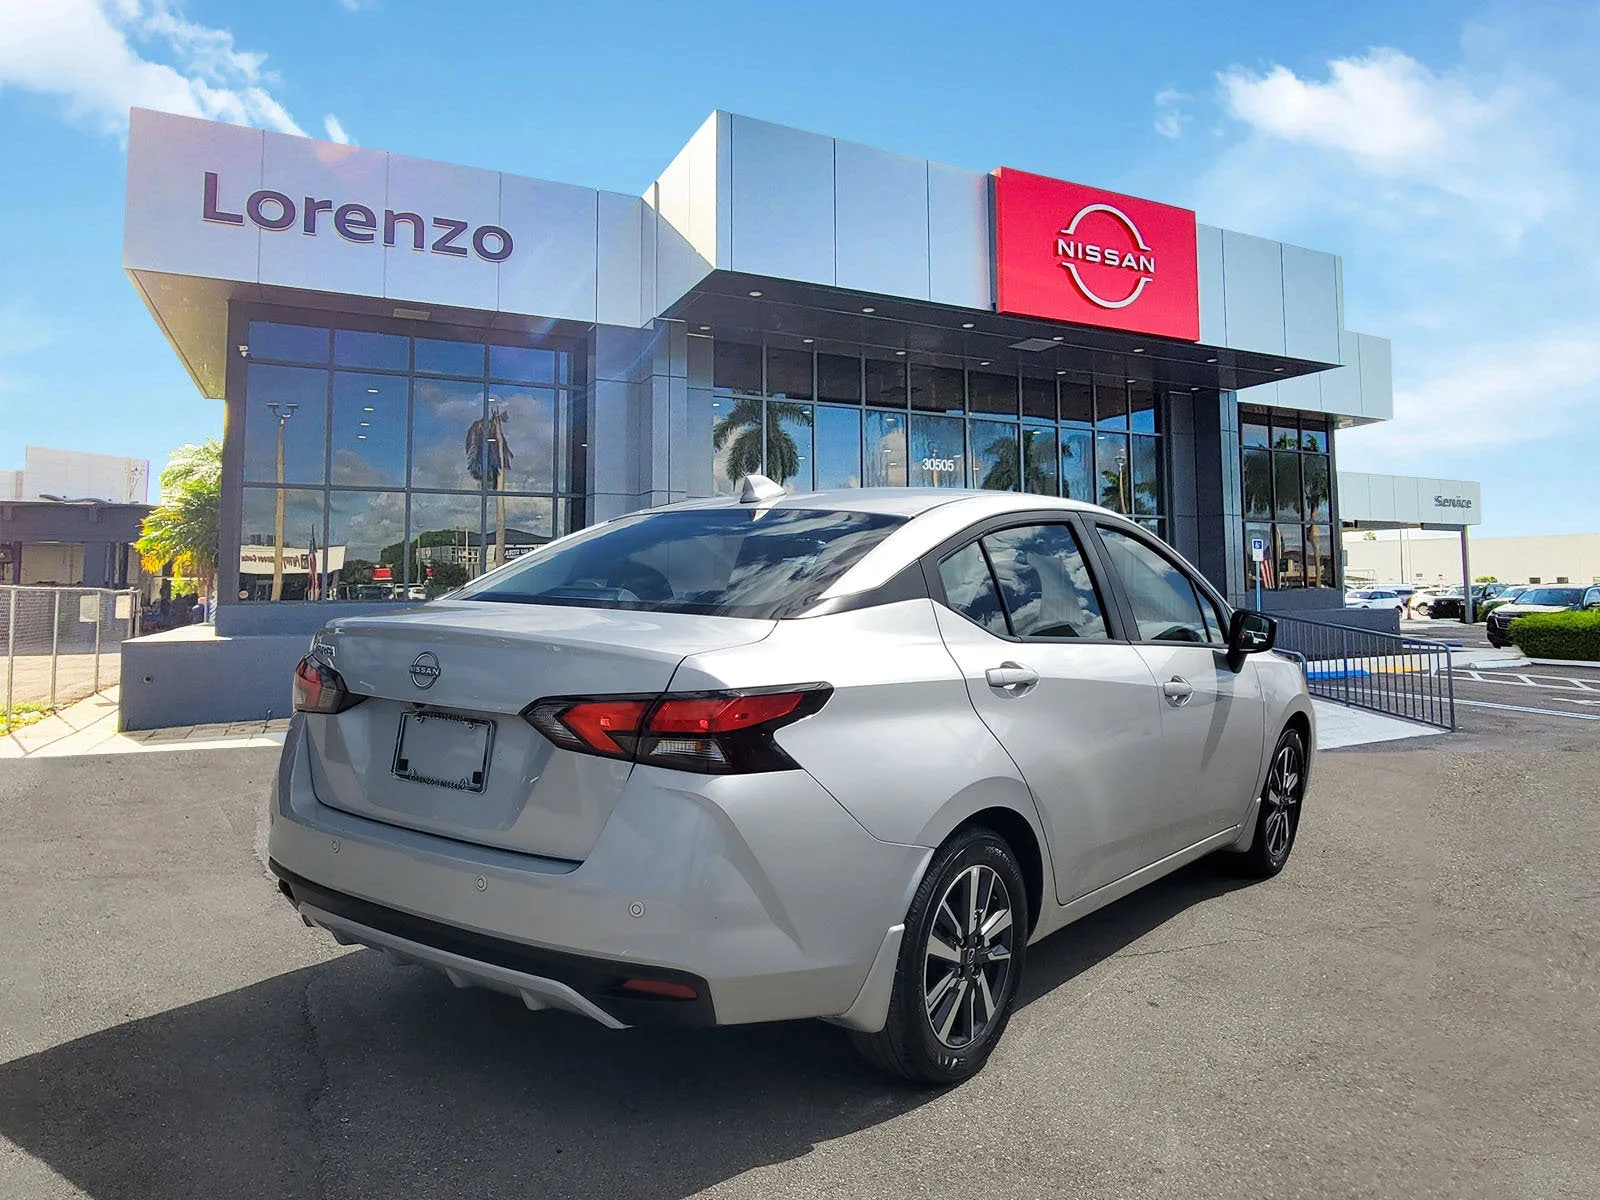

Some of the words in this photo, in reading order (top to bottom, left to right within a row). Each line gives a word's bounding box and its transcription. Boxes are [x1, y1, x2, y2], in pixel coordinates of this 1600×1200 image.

[202, 171, 515, 263] Lorenzo
[1057, 238, 1155, 273] NISSAN
[922, 458, 955, 471] 30505
[1434, 495, 1472, 509] Service
[409, 664, 441, 677] NISSAN
